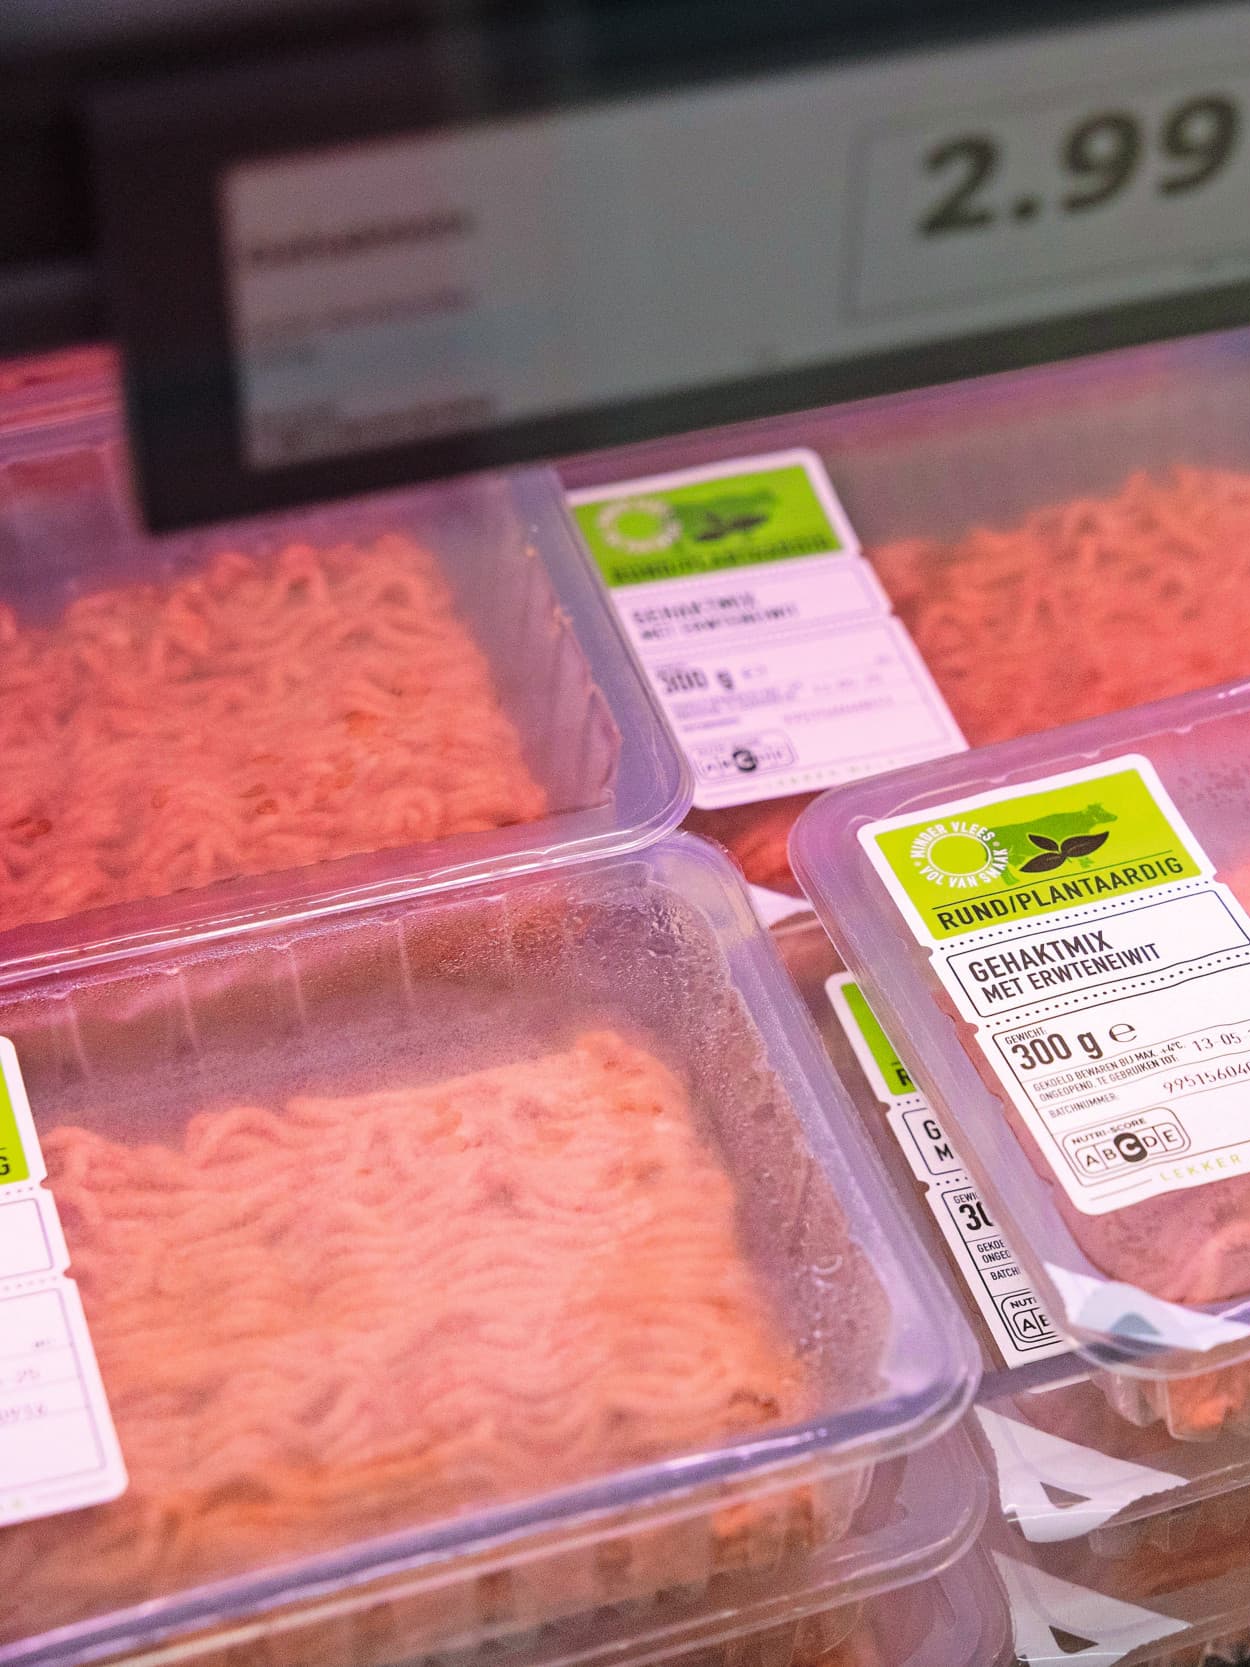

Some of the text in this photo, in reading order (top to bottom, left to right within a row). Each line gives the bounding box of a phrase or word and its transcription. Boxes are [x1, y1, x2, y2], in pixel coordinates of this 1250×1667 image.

[918, 92, 1241, 239] 2.99
[910, 821, 996, 858] MINDER VLEES
[919, 865, 945, 886] VOL
[949, 875, 978, 888] VAN
[936, 856, 1184, 931] RUND/PLANTAARDIG
[968, 930, 1114, 983] GEHAKTMIX
[981, 943, 1162, 1004] MET ERWTENEIWIT
[1011, 1033, 1073, 1070] 300
[1077, 1031, 1104, 1060] g
[1033, 1073, 1075, 1093] GEKOELD
[1076, 1060, 1119, 1081] BEWAREN
[1119, 1055, 1135, 1067] BIJ
[1108, 1060, 1160, 1082] GEBRUIKEN
[1071, 1117, 1148, 1145] NUTRI-SCORE
[1159, 1154, 1243, 1182] LEKKER
[953, 1191, 980, 1205] GEWI
[990, 1266, 1021, 1282] BATCH
[1010, 1296, 1038, 1310] NUT
